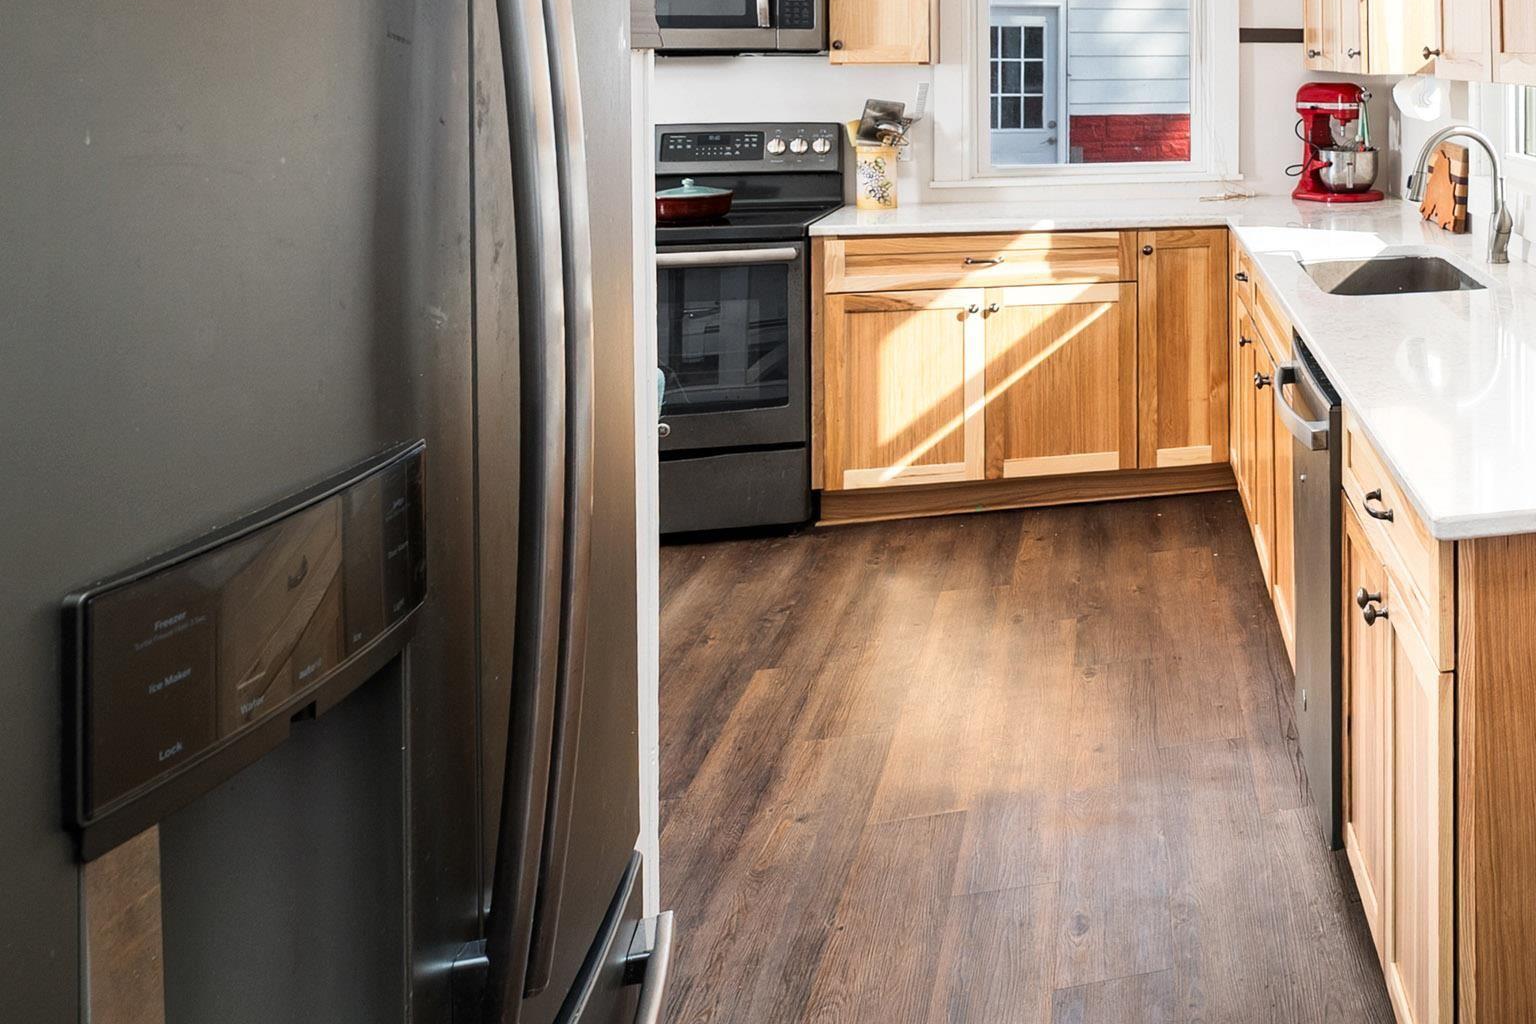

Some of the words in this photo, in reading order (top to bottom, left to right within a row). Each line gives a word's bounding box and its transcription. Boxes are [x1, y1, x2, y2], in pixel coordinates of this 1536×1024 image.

[154, 611, 187, 631] Freezer
[149, 682, 163, 694] Ice
[164, 667, 192, 687] Maker
[240, 695, 265, 715] Water
[159, 741, 183, 761] Lock
